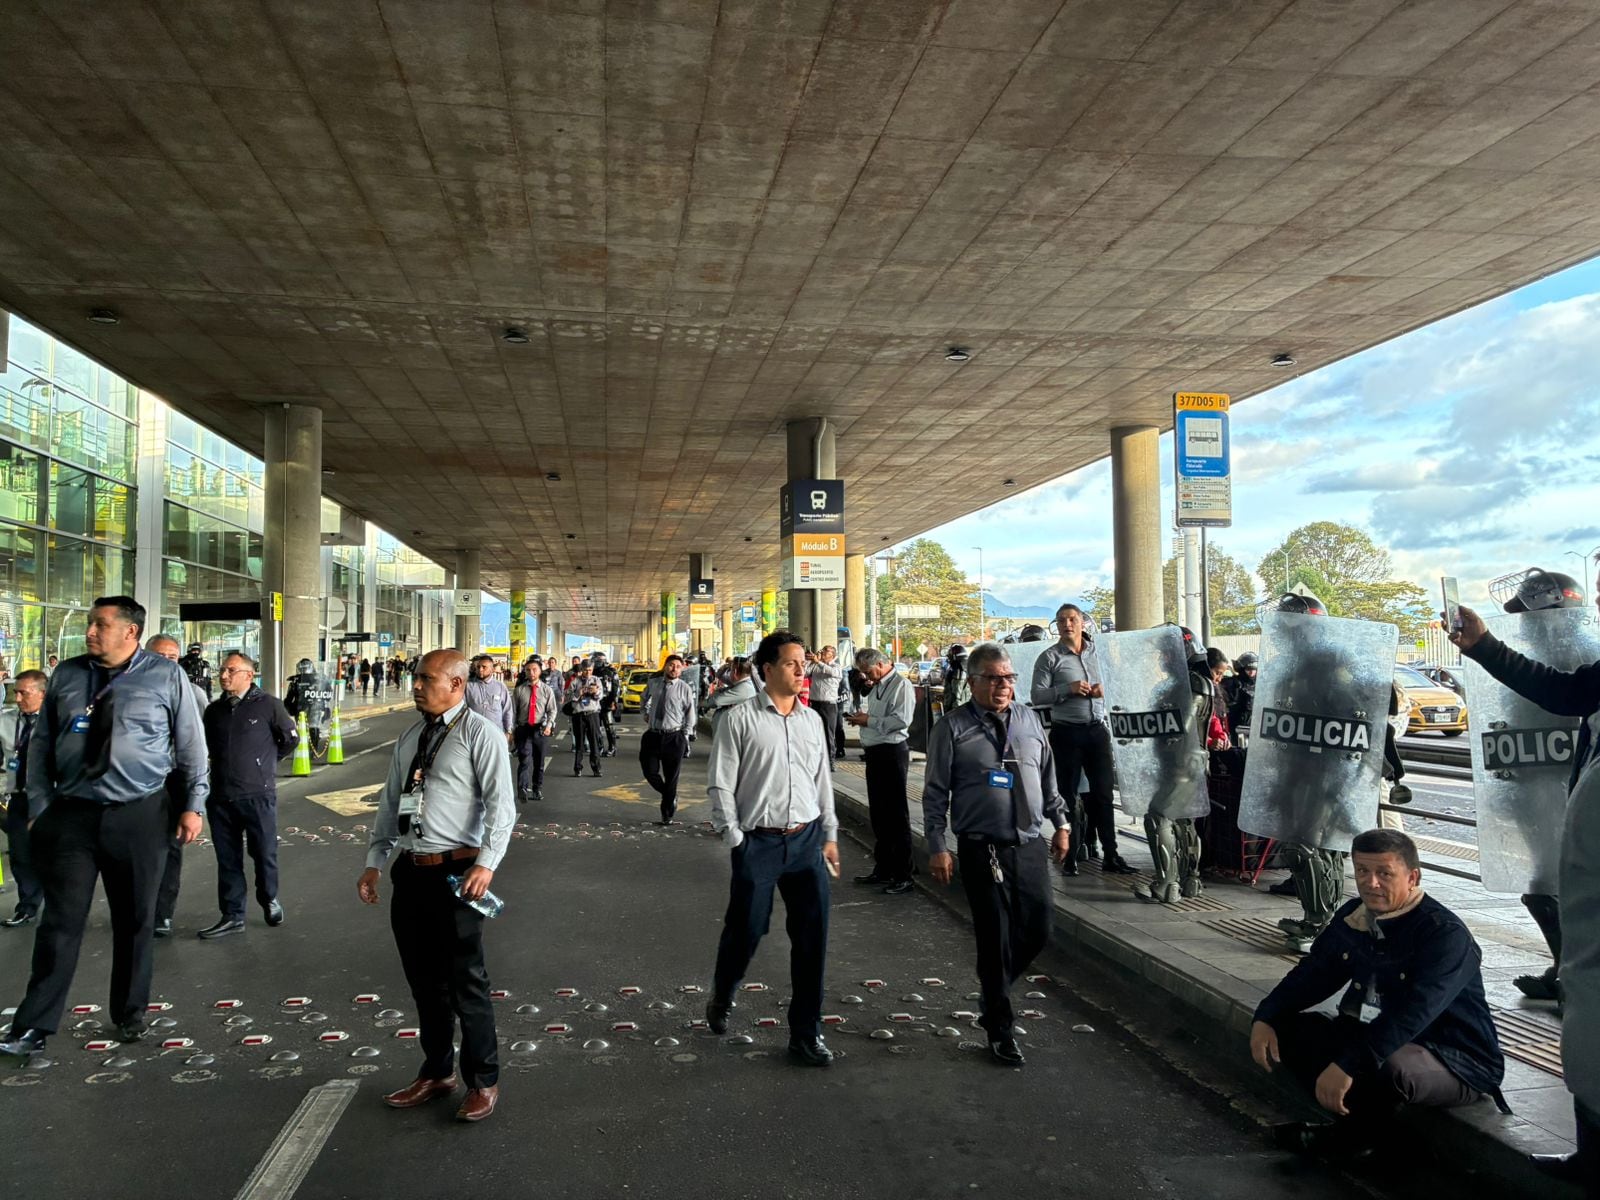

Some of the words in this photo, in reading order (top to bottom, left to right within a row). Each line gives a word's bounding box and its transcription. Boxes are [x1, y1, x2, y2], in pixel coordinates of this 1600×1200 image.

[801, 541, 828, 551] Módulo
[830, 537, 837, 550] B
[1112, 712, 1180, 735] POLICIA
[1261, 711, 1370, 749] POLICIA
[1483, 730, 1580, 765] POLIC
